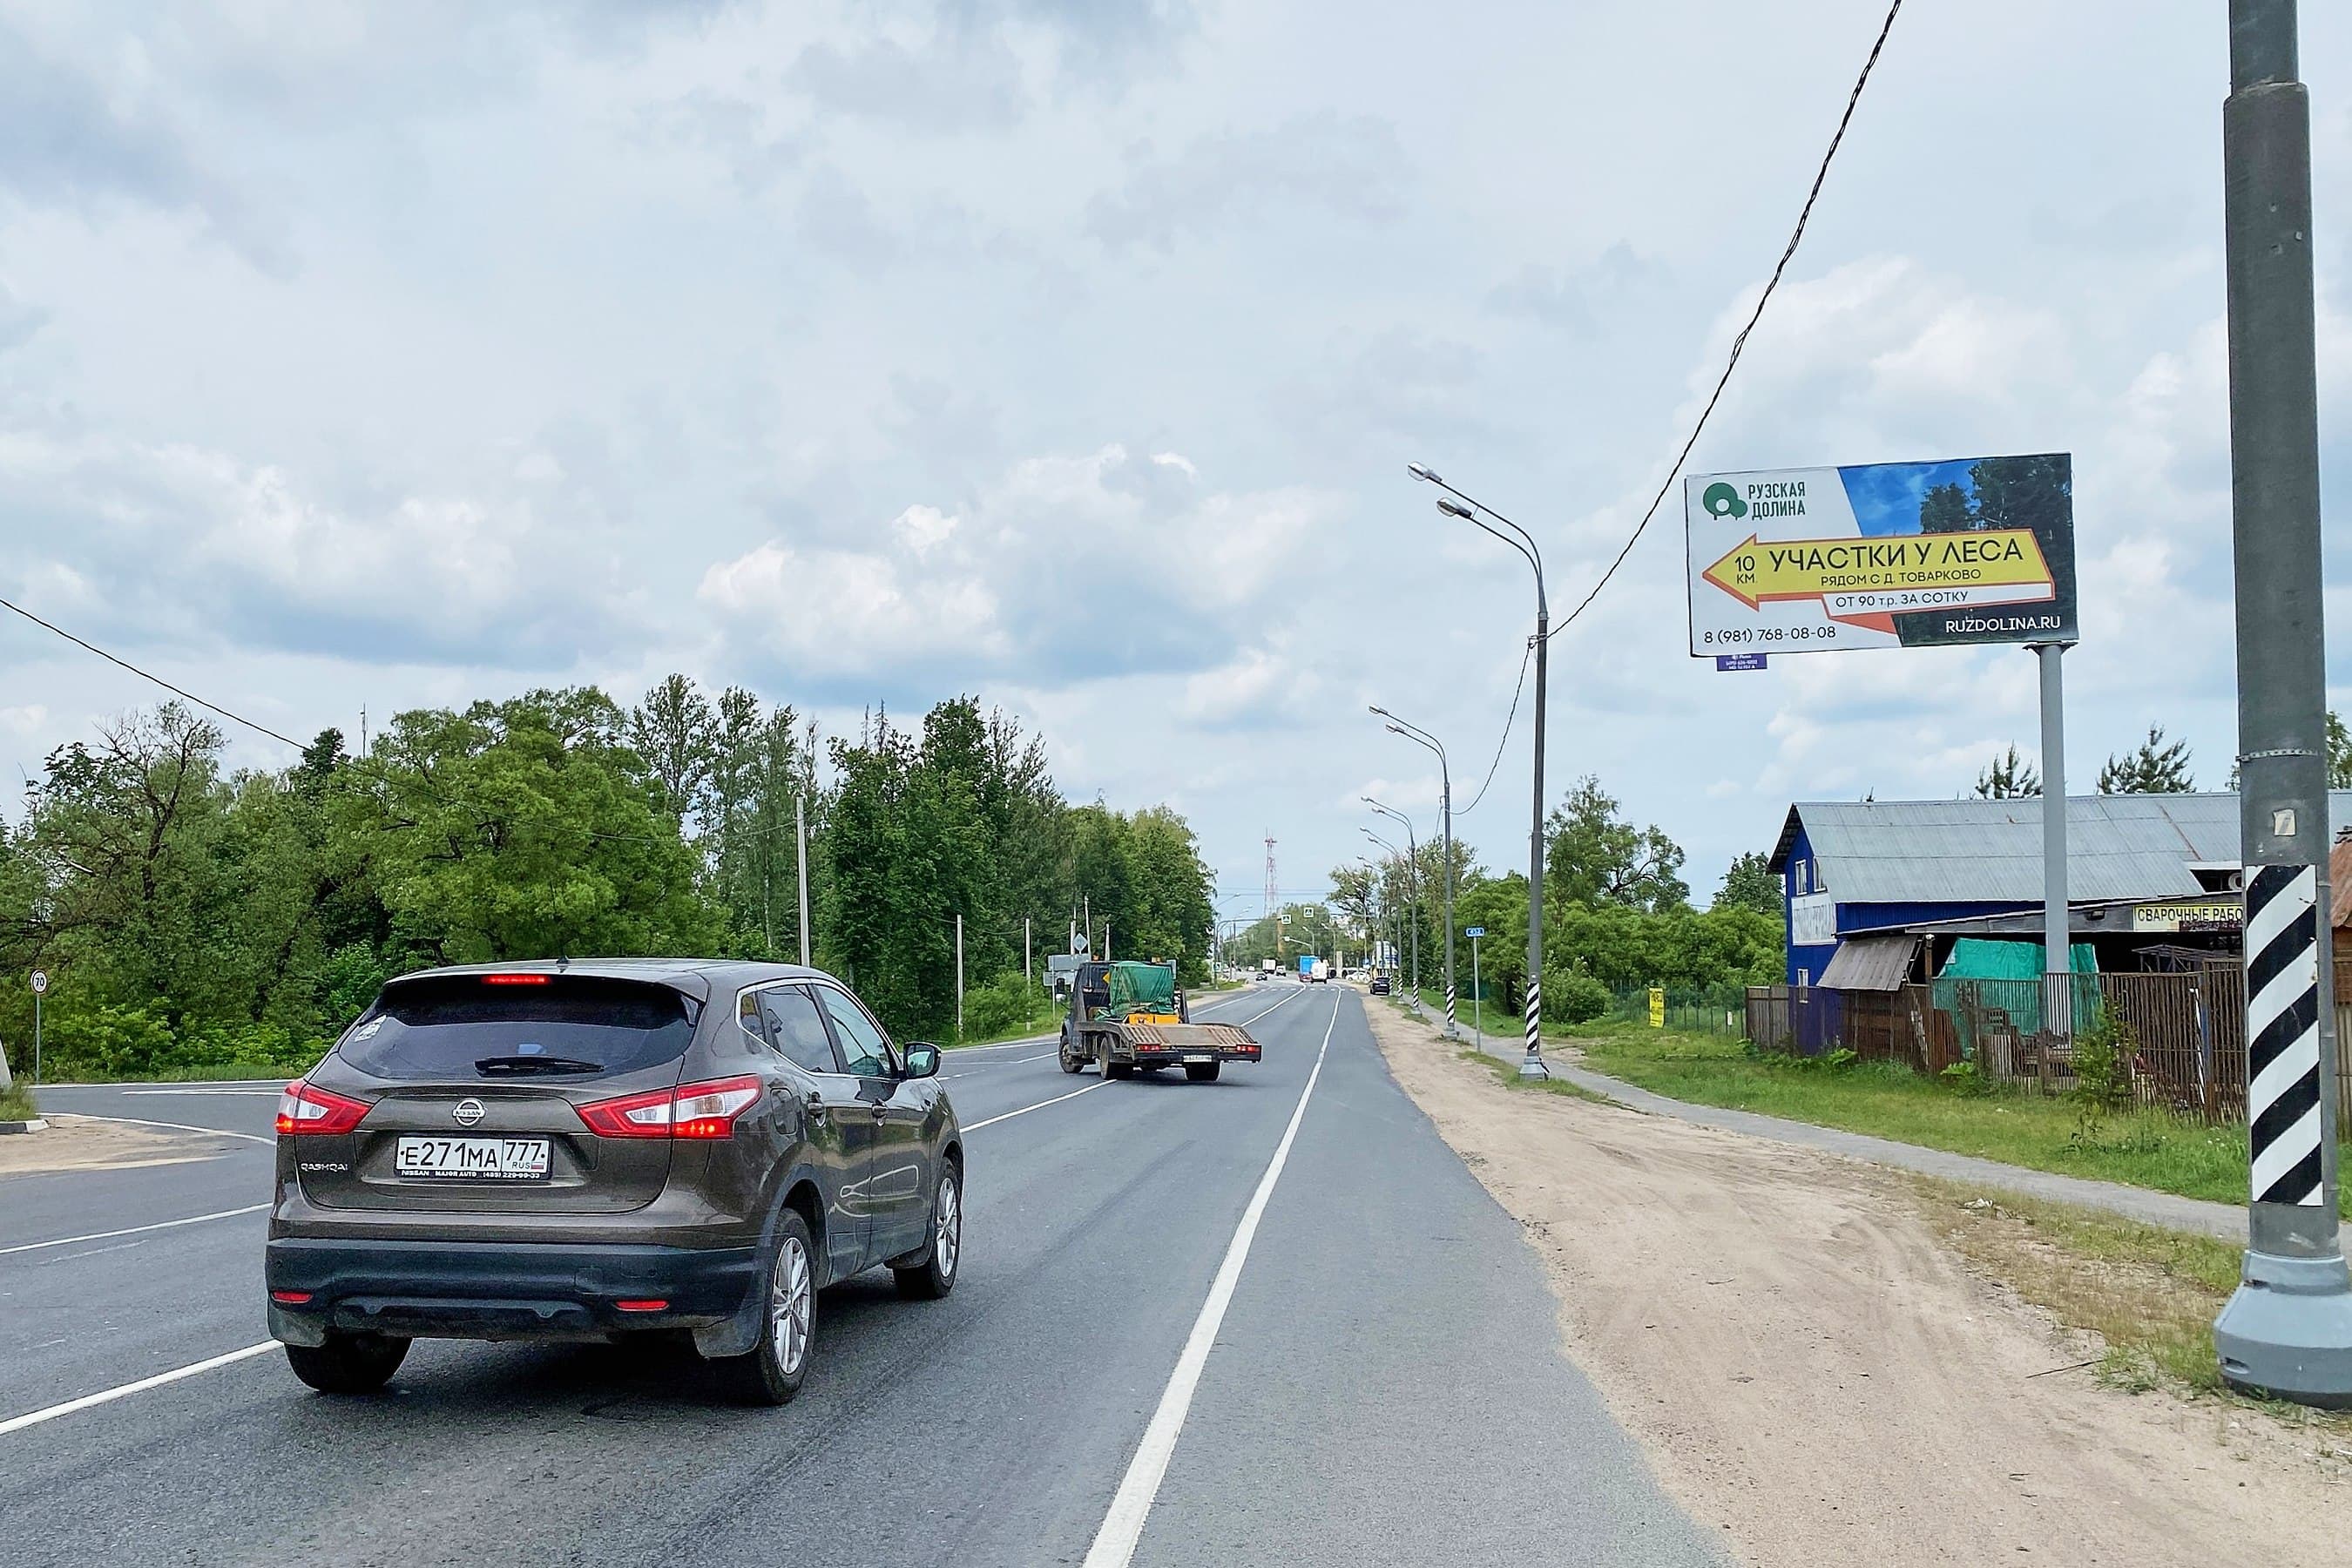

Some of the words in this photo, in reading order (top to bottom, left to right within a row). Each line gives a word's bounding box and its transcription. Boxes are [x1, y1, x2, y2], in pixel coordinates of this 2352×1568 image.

[1748, 482, 1805, 499] РУЗСКАЯ
[1752, 500, 1805, 520] ДОЛИНА
[1769, 544, 1905, 571] УЧАСТКИ
[1915, 543, 1931, 564] У
[1942, 537, 2024, 564] ЛЕСА
[1734, 556, 1755, 571] 10
[1821, 574, 1867, 586] РЯДОМ
[1870, 574, 1880, 585] С
[1899, 569, 1981, 583] ТОВАРКОВО
[1835, 597, 1855, 608] ОТ
[1858, 595, 1875, 606] 90
[1901, 594, 1916, 605] ЗА
[1922, 591, 1969, 604] СОТКУ
[1945, 616, 2060, 633] RUZDOLINA.RU
[1704, 632, 1713, 643] 8
[1717, 628, 1753, 645] (981)
[1757, 626, 1836, 641] 768-08-08
[2138, 908, 2209, 922] СВАРОЧНЫЕ
[2213, 908, 2243, 922] РАБО
[35, 977, 44, 987] 70
[505, 1142, 542, 1161] 777
[301, 1163, 348, 1173] QASHQAI
